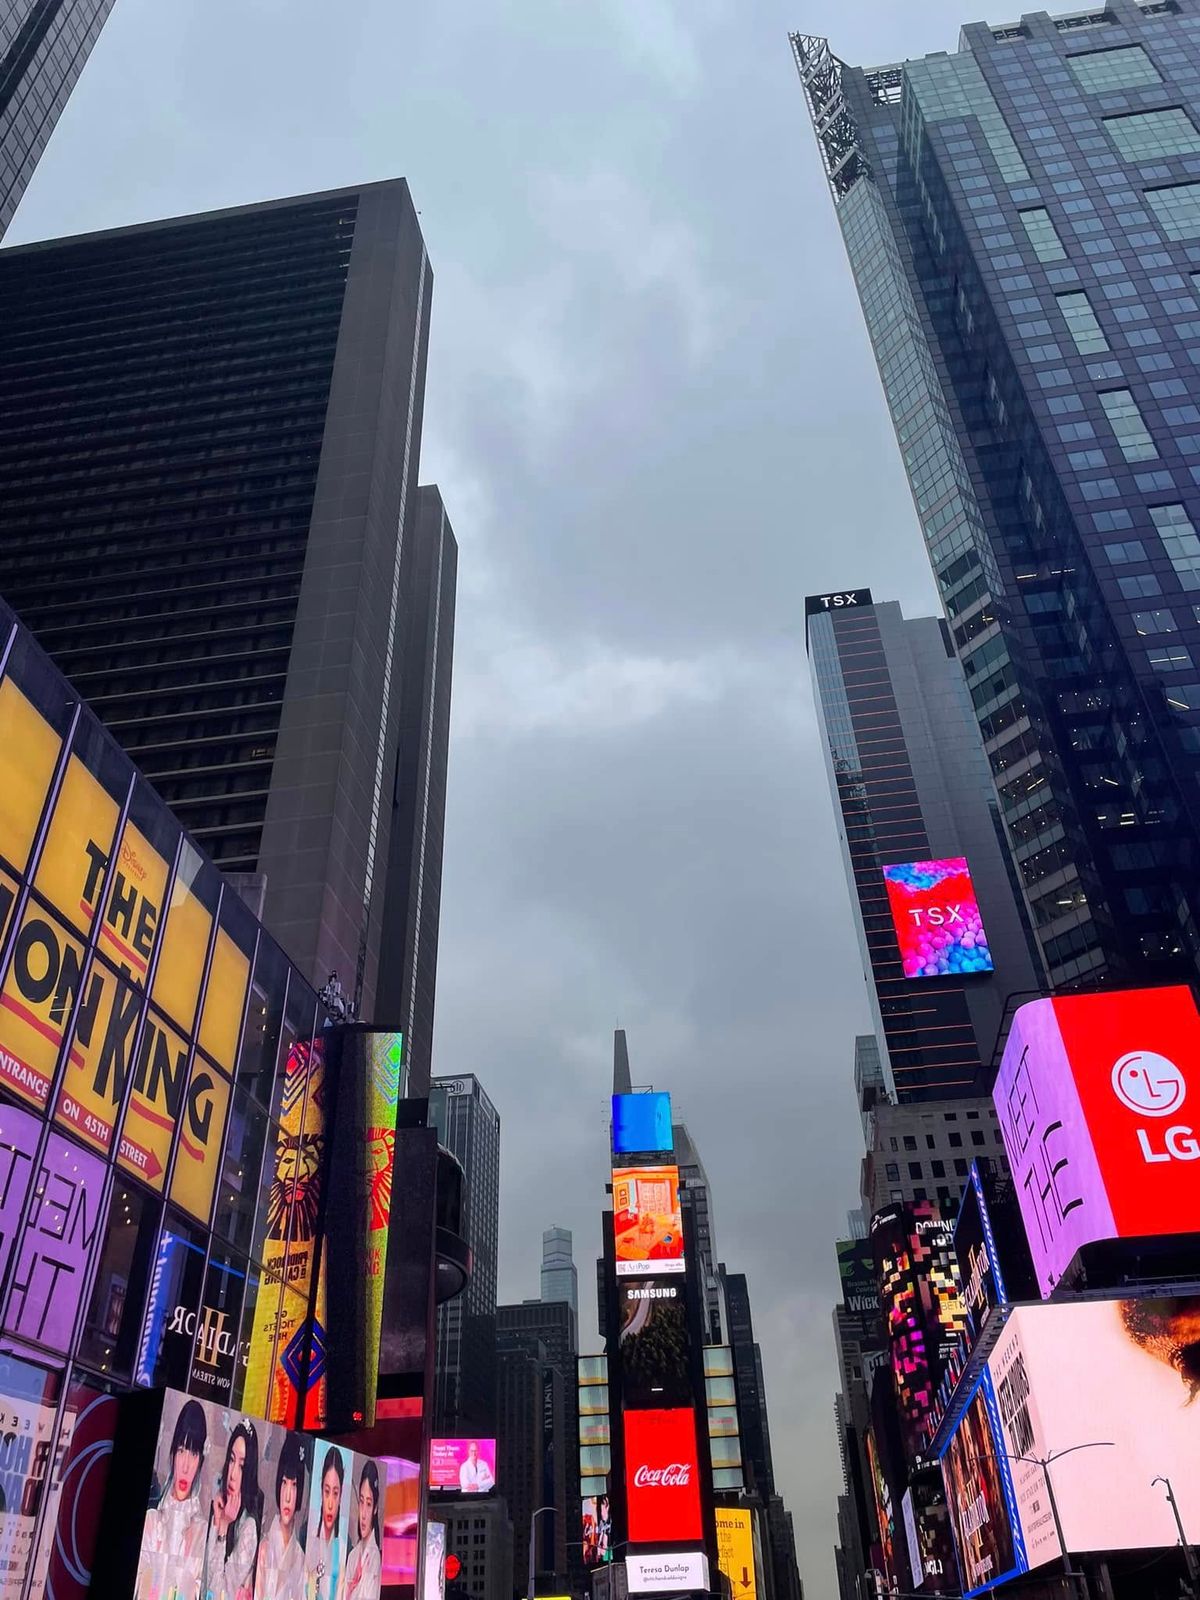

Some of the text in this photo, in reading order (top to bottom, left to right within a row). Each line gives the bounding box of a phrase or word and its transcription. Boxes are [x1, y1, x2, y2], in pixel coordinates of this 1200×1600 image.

[820, 593, 857, 608] TSX
[82, 839, 157, 961] THE
[908, 904, 965, 928] TSX
[93, 962, 214, 1146] KING
[1001, 1045, 1040, 1169] MEET
[62, 1098, 80, 1121] ON
[84, 1113, 110, 1143] 45TH
[120, 1139, 149, 1169] STREET
[1136, 1125, 1200, 1163] LG
[1023, 1120, 1084, 1254] THE
[627, 1287, 677, 1300] SAMSUNG
[634, 1463, 692, 1488] Coca-Cola
[735, 1518, 745, 1529] in
[639, 1563, 690, 1574] Teresa Dunlap
